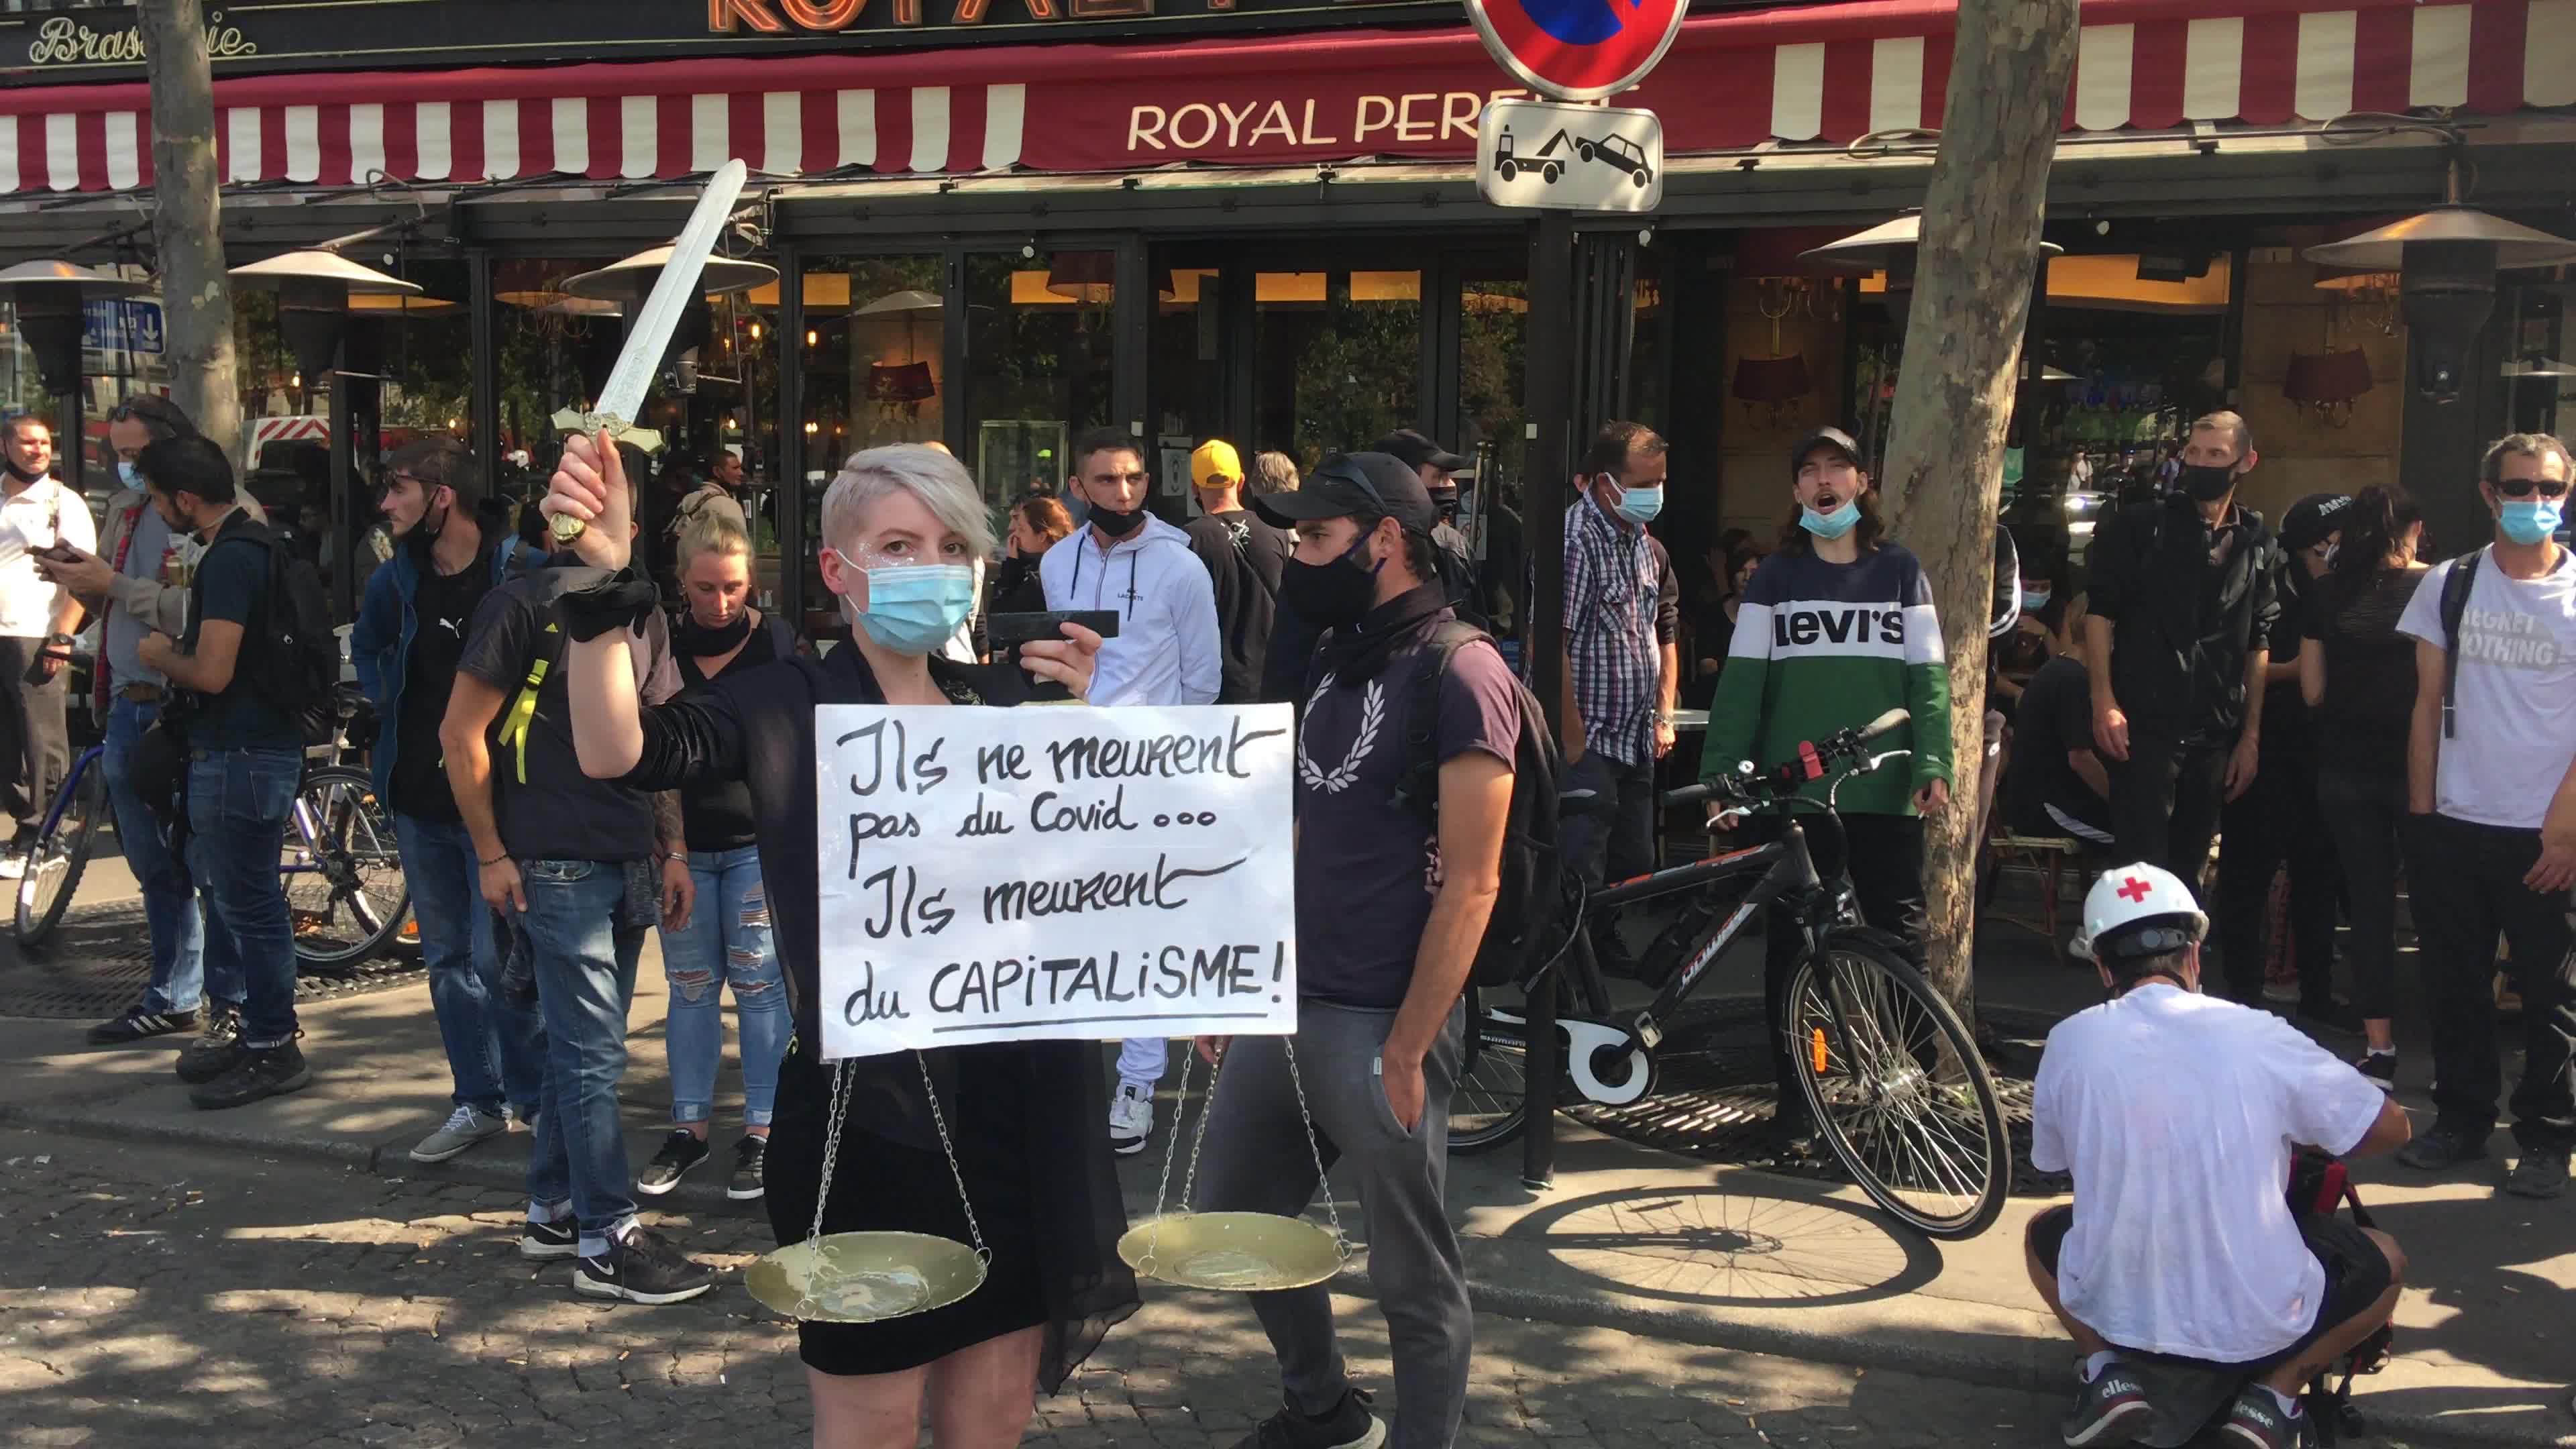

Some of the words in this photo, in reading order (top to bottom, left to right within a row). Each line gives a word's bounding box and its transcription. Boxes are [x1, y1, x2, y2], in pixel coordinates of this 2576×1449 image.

[1128, 99, 1337, 150] ROYAL
[977, 743, 1031, 784] ne
[1046, 714, 1287, 780] meurent
[849, 810, 921, 879] pas
[955, 792, 1014, 838] du
[1030, 784, 1138, 833] Covid
[983, 853, 1248, 924] meurent
[844, 961, 910, 1027] du
